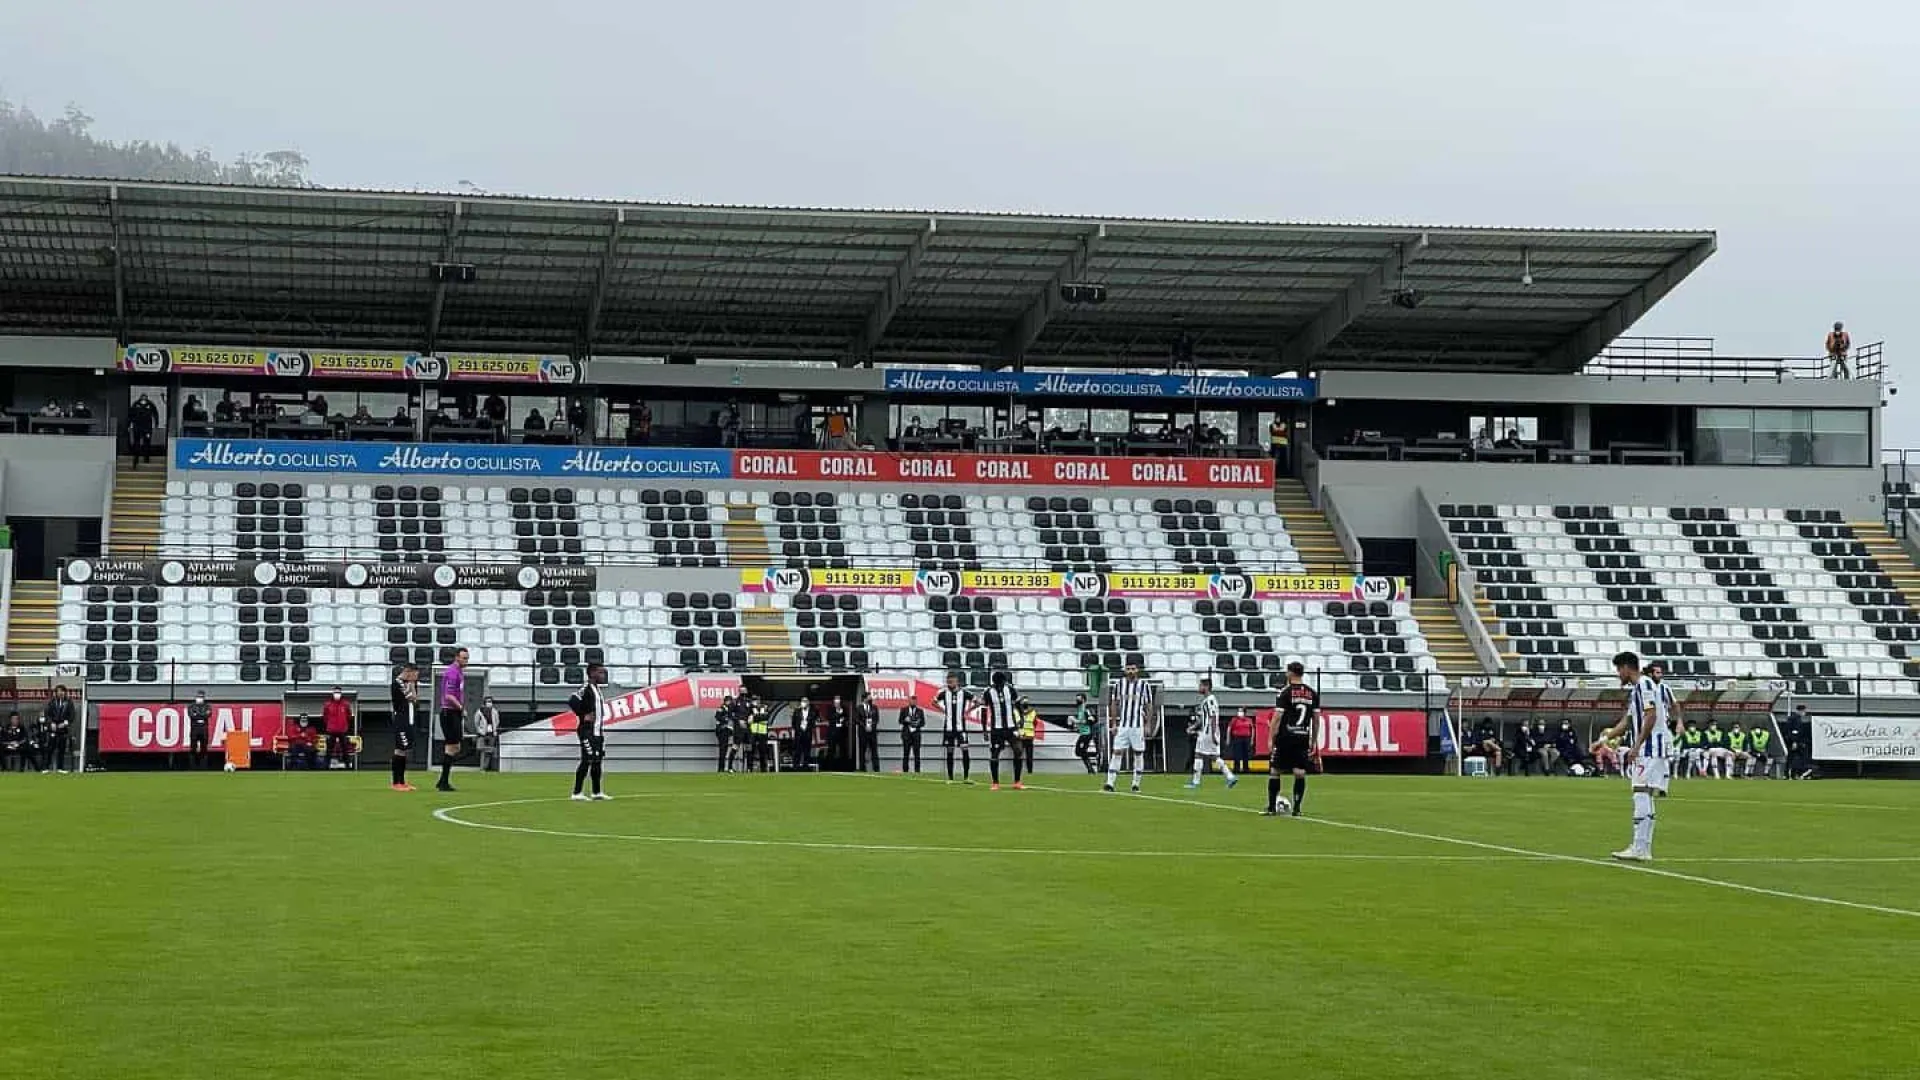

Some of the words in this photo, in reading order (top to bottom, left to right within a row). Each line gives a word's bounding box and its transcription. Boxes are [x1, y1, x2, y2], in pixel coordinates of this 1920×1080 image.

[136, 352, 160, 365] NP
[181, 352, 201, 363] 291
[206, 352, 229, 364] 625
[232, 353, 255, 364] 076
[278, 356, 301, 369] NP
[321, 356, 341, 367] 291
[346, 357, 368, 368] 625
[371, 358, 393, 369] 076
[415, 361, 438, 373] NP
[458, 360, 478, 370] 291
[483, 360, 504, 371] 625
[507, 361, 529, 372] 076
[551, 363, 573, 376] NP
[889, 372, 956, 390] Alberto
[958, 379, 1020, 392] OCULISTA
[1035, 375, 1100, 393] Alberto
[1102, 383, 1163, 395] OCULISTA
[1177, 378, 1241, 396] Alberto
[1243, 385, 1304, 397] OCULISTA
[189, 443, 275, 466] Alberto
[278, 453, 357, 468] OCULISTA
[379, 447, 461, 469] Alberto
[464, 456, 541, 471] OCULISTA
[562, 450, 643, 473] Alberto
[646, 460, 720, 474] OCULISTA
[740, 456, 797, 474] CORAL
[820, 457, 877, 476] CORAL
[900, 459, 956, 477] CORAL
[976, 460, 1032, 479] CORAL
[1054, 462, 1110, 481] CORAL
[1132, 463, 1187, 482] CORAL
[1209, 464, 1264, 483] CORAL
[776, 569, 800, 584] NP
[826, 572, 848, 584] 911
[852, 573, 874, 585] 912
[879, 573, 901, 585] 383
[927, 574, 950, 588] NP
[975, 575, 997, 586] 911
[1001, 575, 1023, 587] 912
[1027, 576, 1049, 587] 383
[1075, 576, 1098, 590] NP
[1122, 577, 1144, 588] 911
[1148, 577, 1170, 589] 912
[1174, 578, 1196, 589] 383
[1220, 578, 1244, 591] NP
[1267, 579, 1289, 590] 911
[1293, 579, 1315, 591] 912
[1319, 580, 1341, 591] 383
[1364, 580, 1388, 593] NP
[700, 686, 738, 699] CORAL
[870, 687, 908, 700] CORAL
[602, 688, 668, 721] ORAL
[1296, 704, 1307, 725] 7
[1317, 714, 1400, 752] RAL
[1862, 742, 1916, 756] madeira
